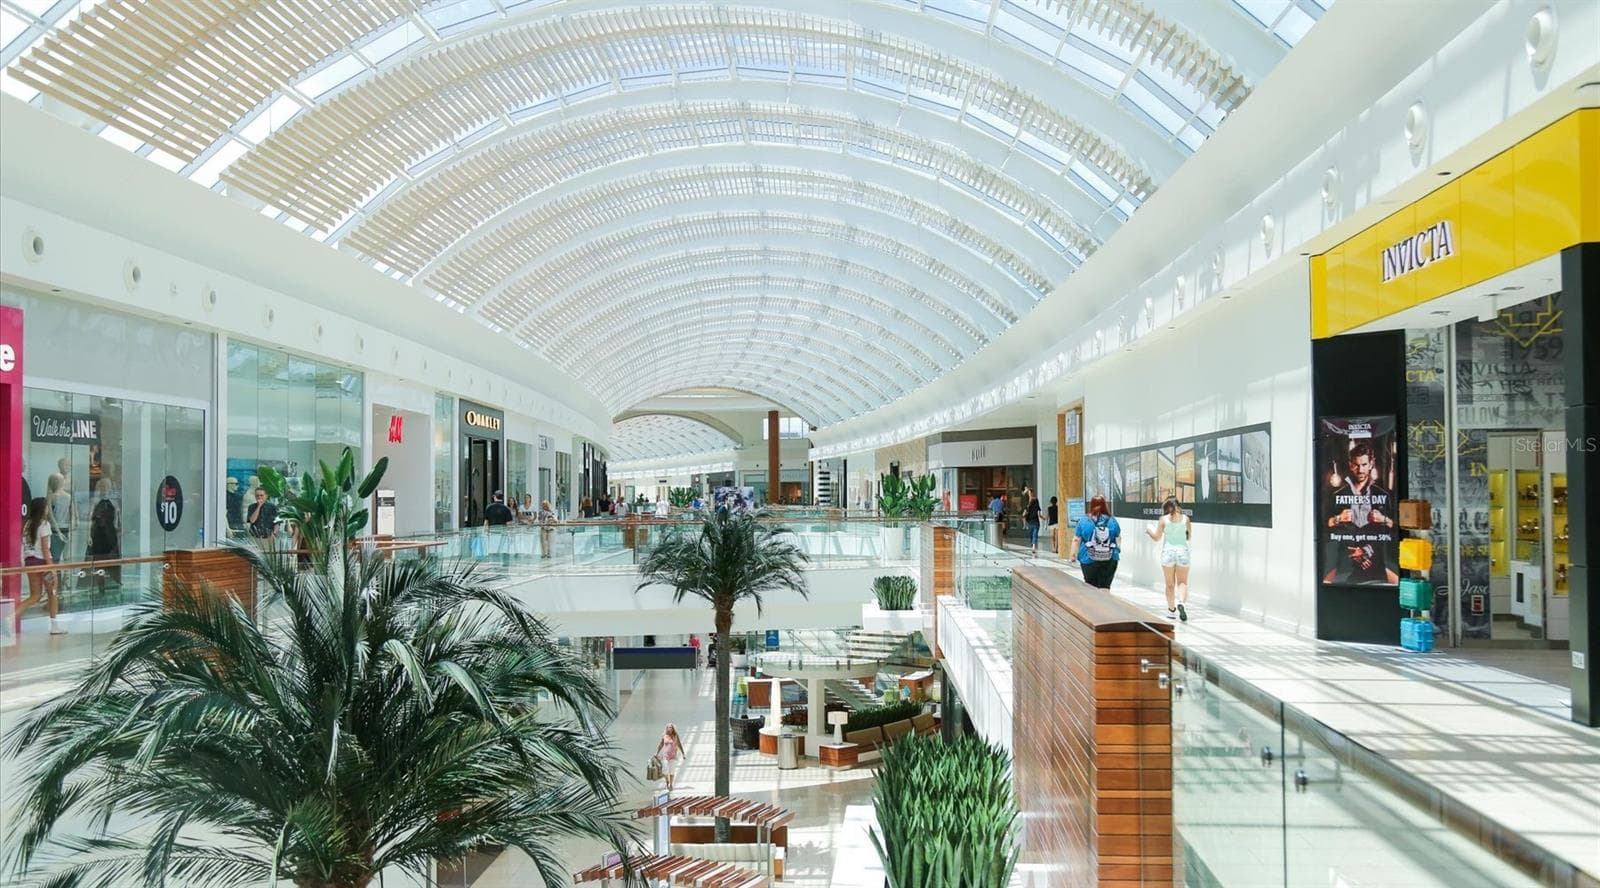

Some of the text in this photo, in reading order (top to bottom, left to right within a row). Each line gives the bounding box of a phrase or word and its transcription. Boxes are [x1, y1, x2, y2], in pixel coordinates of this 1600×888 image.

[1382, 222, 1453, 282] INVICTA
[33, 415, 97, 439] Walk the LINE
[1335, 495, 1387, 505] FATHER'S DAY
[161, 501, 177, 524] $10
[1330, 533, 1342, 541] Buy
[1355, 534, 1366, 542] get
